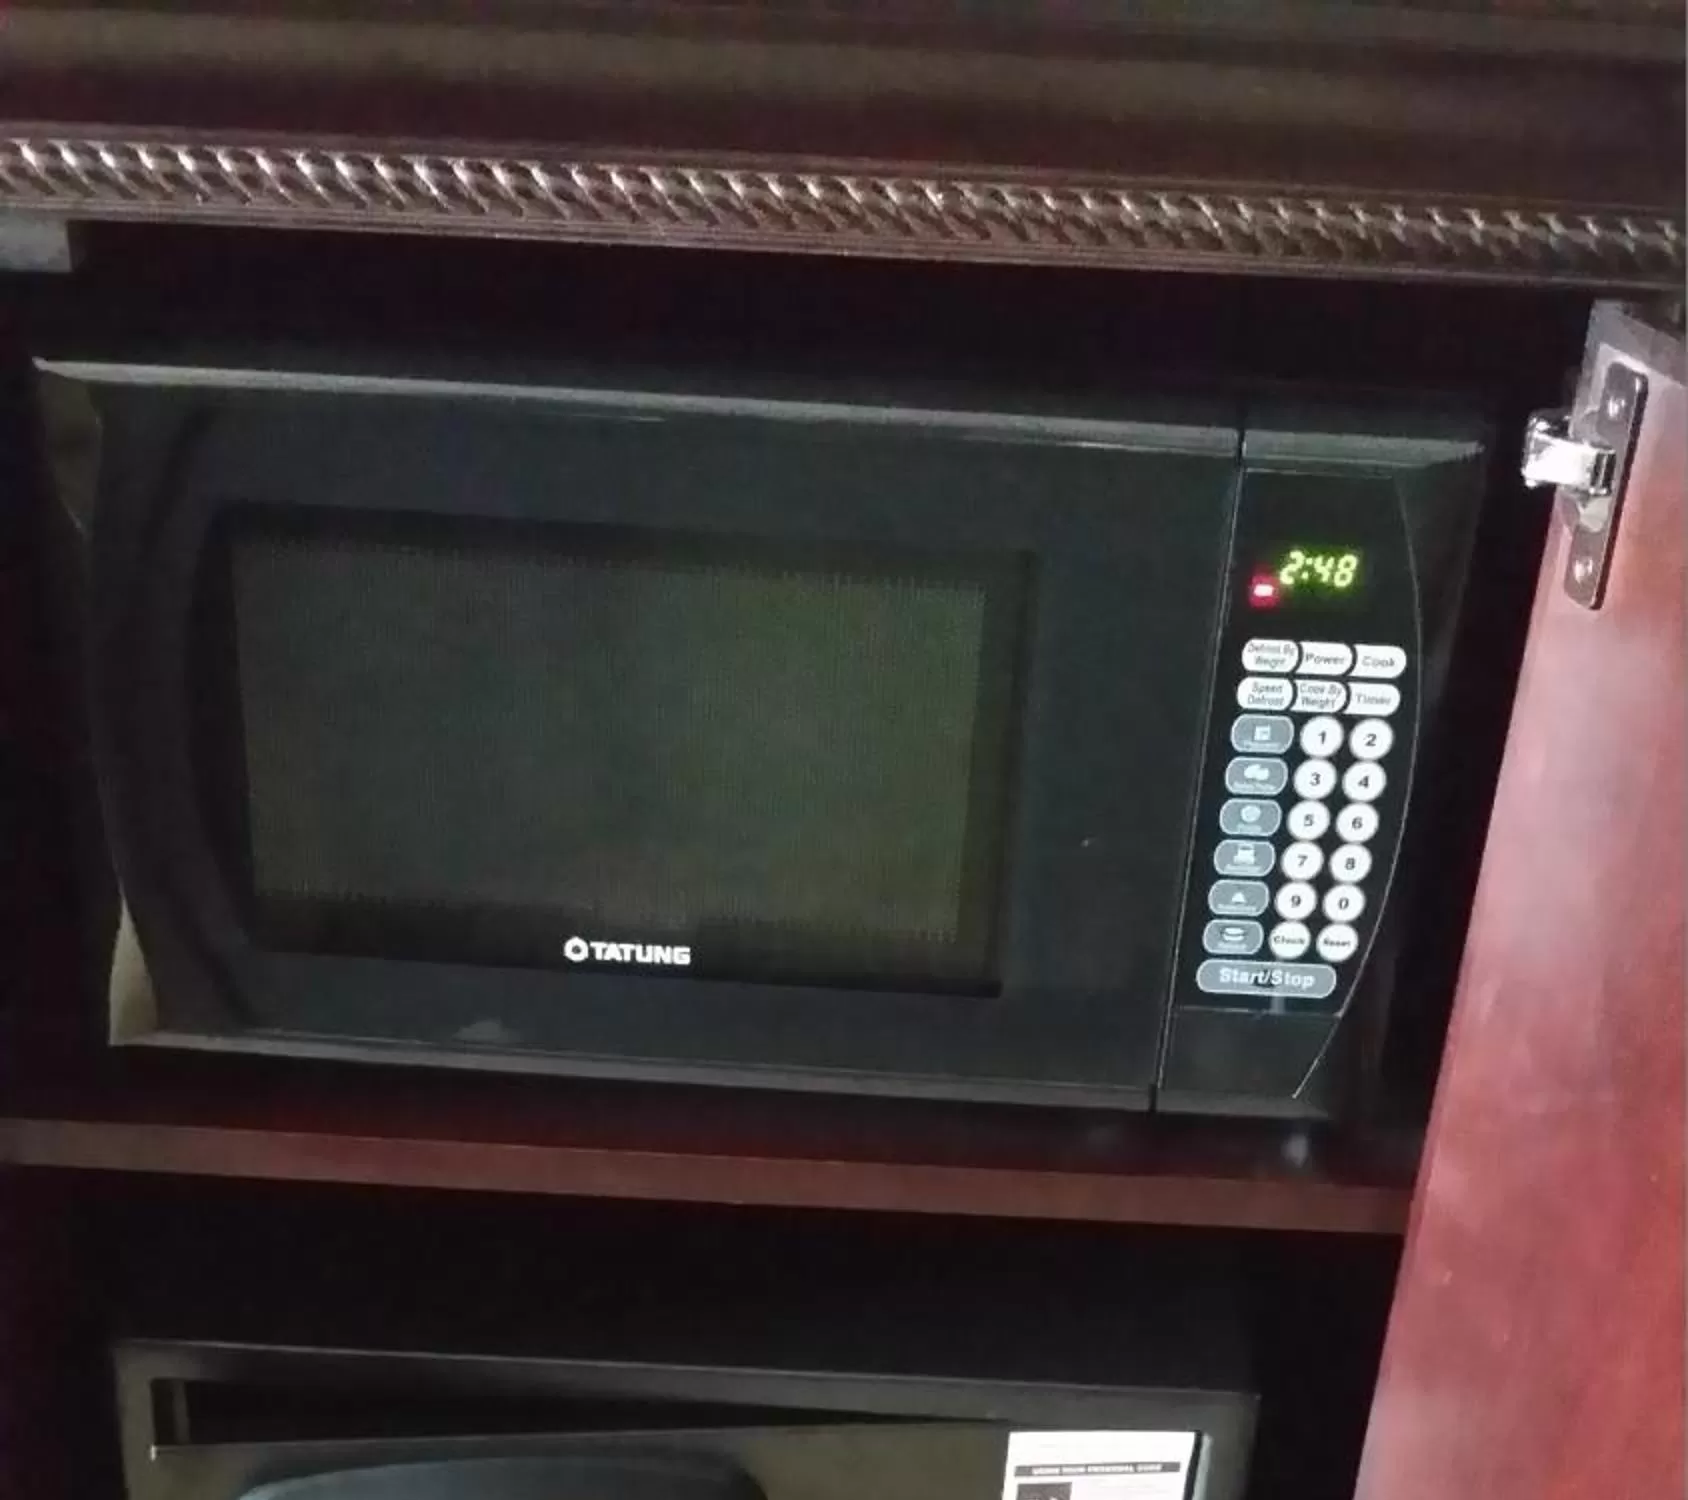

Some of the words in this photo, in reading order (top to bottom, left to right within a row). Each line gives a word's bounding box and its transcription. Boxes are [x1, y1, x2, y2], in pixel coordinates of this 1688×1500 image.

[1279, 550, 1358, 588] 2:48
[1304, 652, 1345, 665] Power
[1361, 655, 1395, 668] Cook
[1251, 682, 1283, 695] Speed
[1317, 731, 1327, 745] 1
[1365, 733, 1377, 747] 2
[1309, 773, 1321, 787] 3
[1357, 775, 1370, 789] 4
[1303, 814, 1314, 828] 5
[1351, 817, 1363, 830] 6
[1297, 855, 1308, 868] 7
[1345, 858, 1356, 871] 8
[1290, 896, 1301, 908] 9
[1338, 898, 1349, 911] 0
[590, 940, 692, 965] TATUNG
[1219, 967, 1316, 989] Start/Stop
